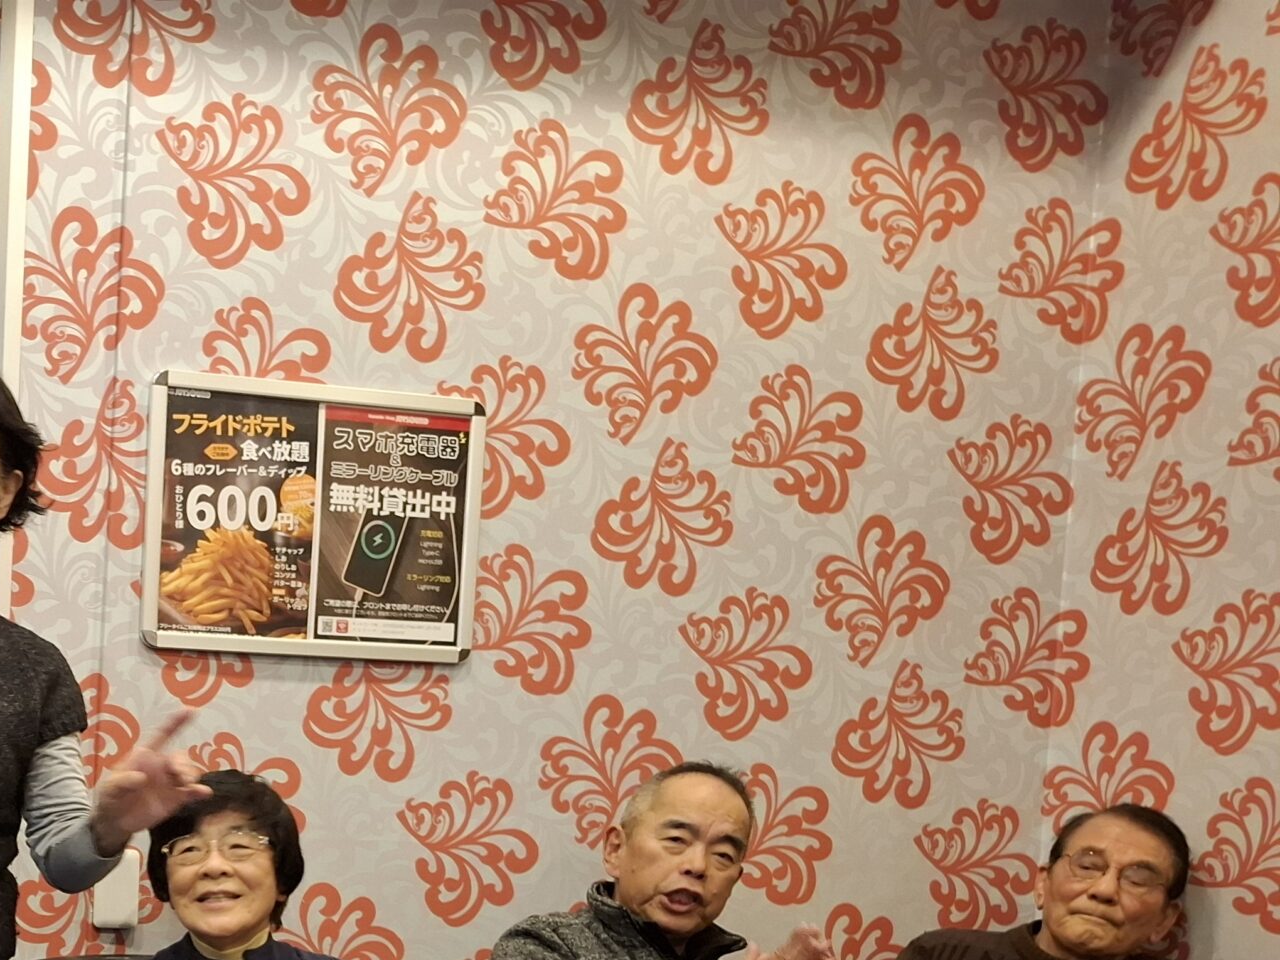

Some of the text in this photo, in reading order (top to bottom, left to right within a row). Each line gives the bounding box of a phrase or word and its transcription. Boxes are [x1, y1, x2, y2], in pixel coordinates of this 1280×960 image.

[172, 413, 295, 438] フライドポテト
[240, 440, 310, 462] 食べ放題
[333, 427, 459, 459] スマホ充電器
[390, 453, 401, 466] &
[330, 461, 458, 487] ミラーリングケーブル
[329, 482, 456, 520] 無料貸出中
